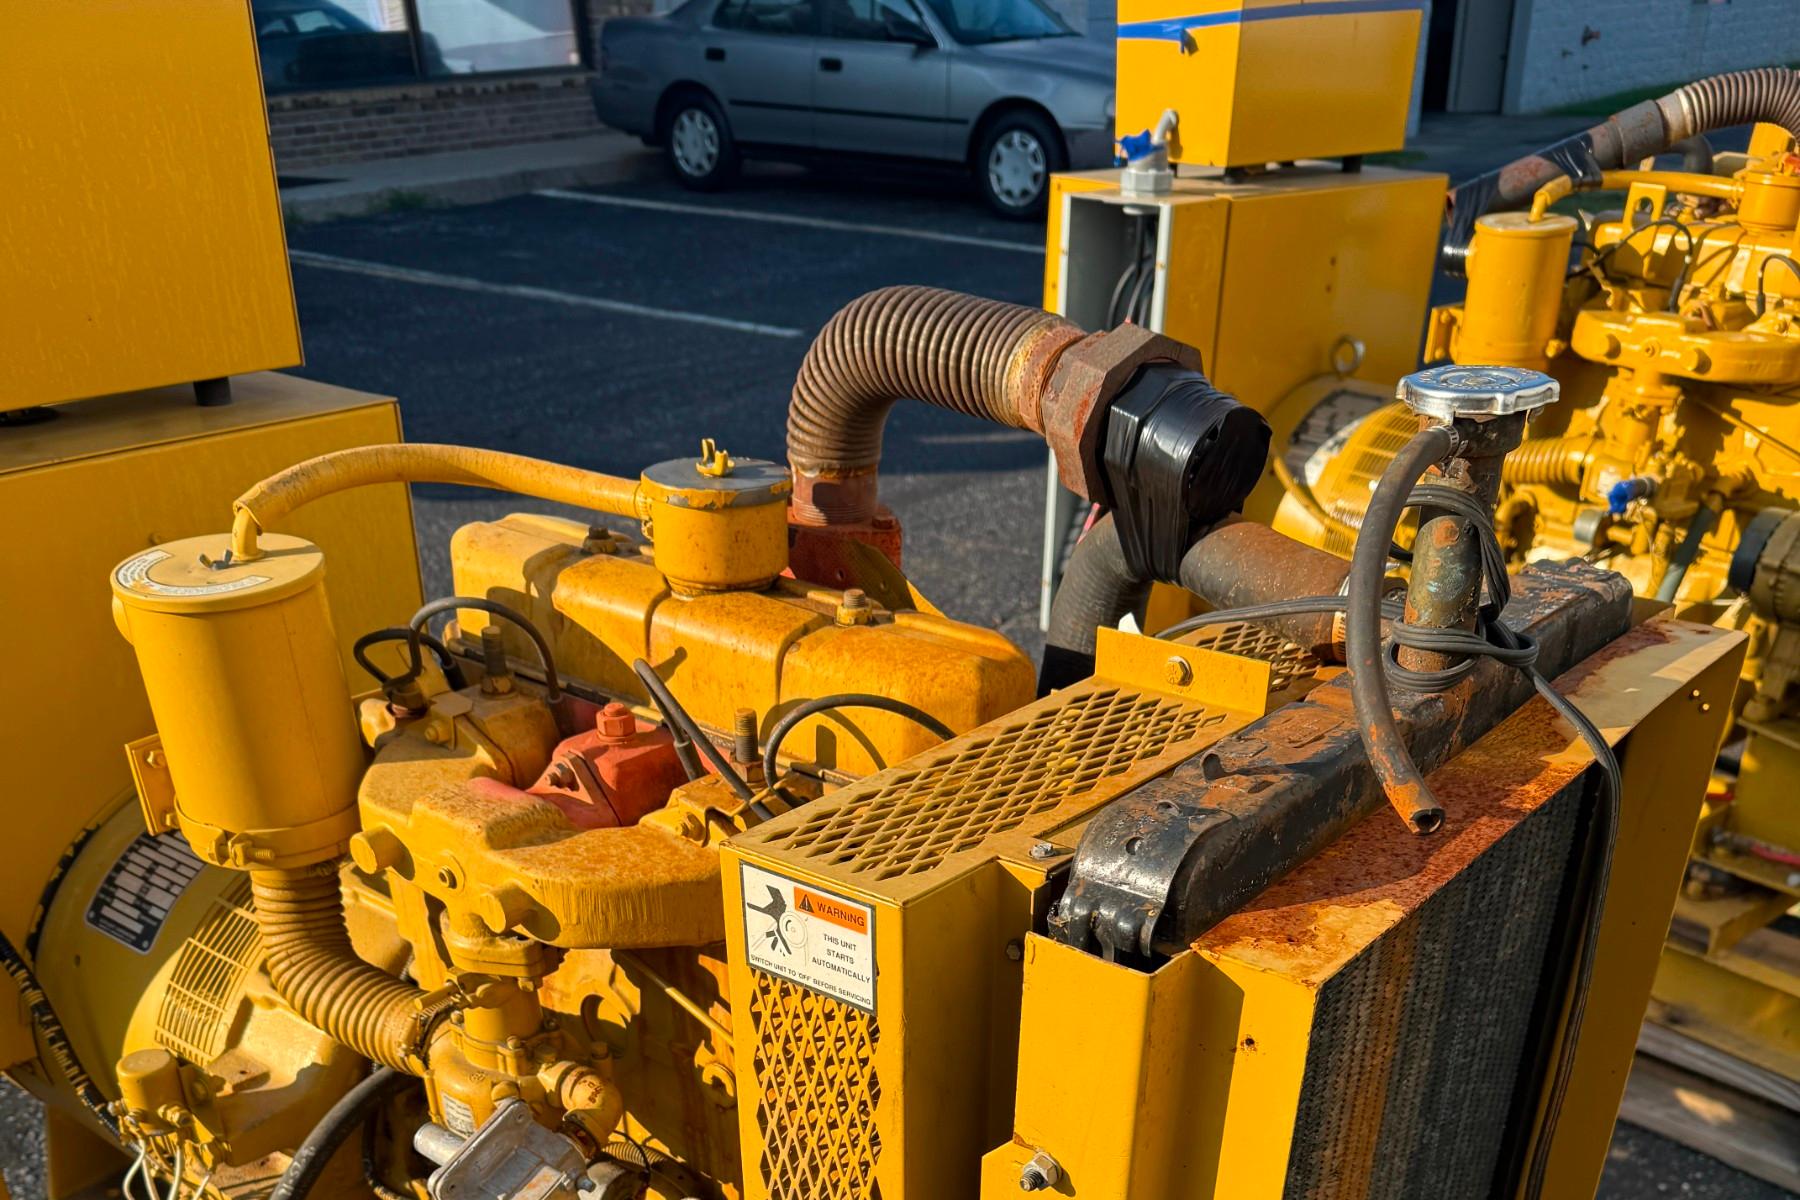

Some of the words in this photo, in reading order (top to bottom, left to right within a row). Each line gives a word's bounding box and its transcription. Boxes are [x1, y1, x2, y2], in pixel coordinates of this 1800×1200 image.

[817, 901, 865, 927] WARNING
[823, 933, 839, 946] THIS
[841, 939, 857, 951] UNIT
[826, 948, 855, 965] STARTS
[751, 953, 773, 968] SWITCH
[774, 962, 787, 973] UNIT
[788, 967, 797, 977] TO
[813, 978, 838, 993] BEFORE
[838, 987, 871, 1006] SERVICING
[812, 956, 871, 984] AUTOMATICALLY
